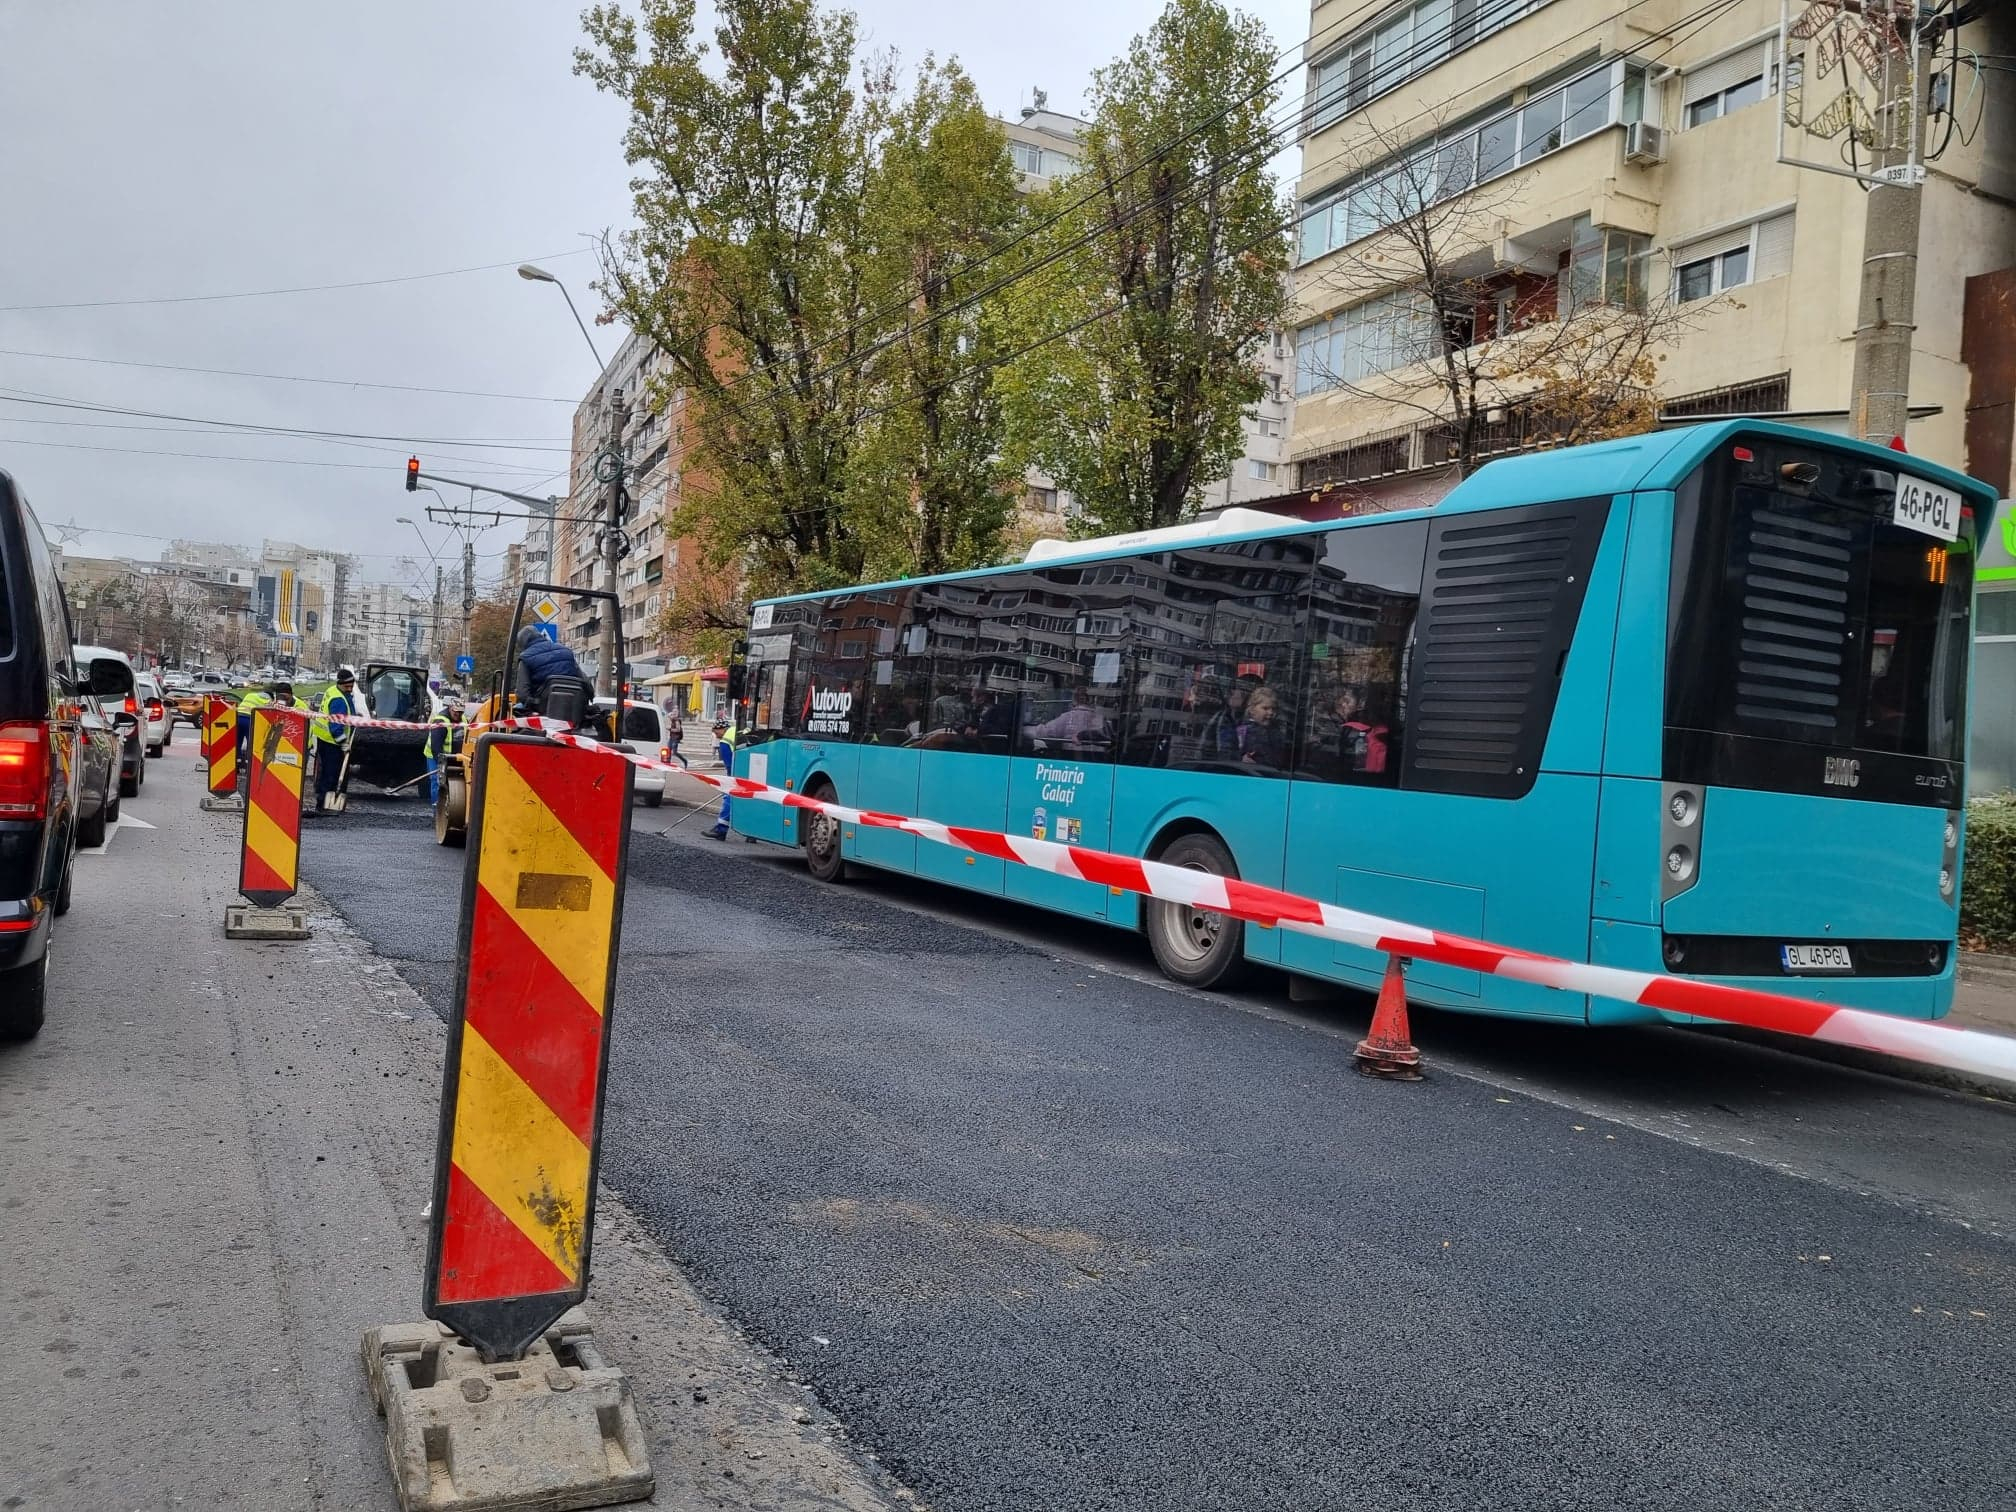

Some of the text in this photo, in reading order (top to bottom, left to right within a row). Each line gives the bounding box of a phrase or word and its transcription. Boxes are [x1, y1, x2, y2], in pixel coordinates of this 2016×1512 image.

[1900, 484, 1951, 530] 46-PGL
[1927, 547, 1946, 584] 11
[827, 720, 838, 733] 574
[1035, 763, 1085, 785] Primăria
[1824, 757, 1860, 788] BMC
[1788, 947, 1806, 966] GL
